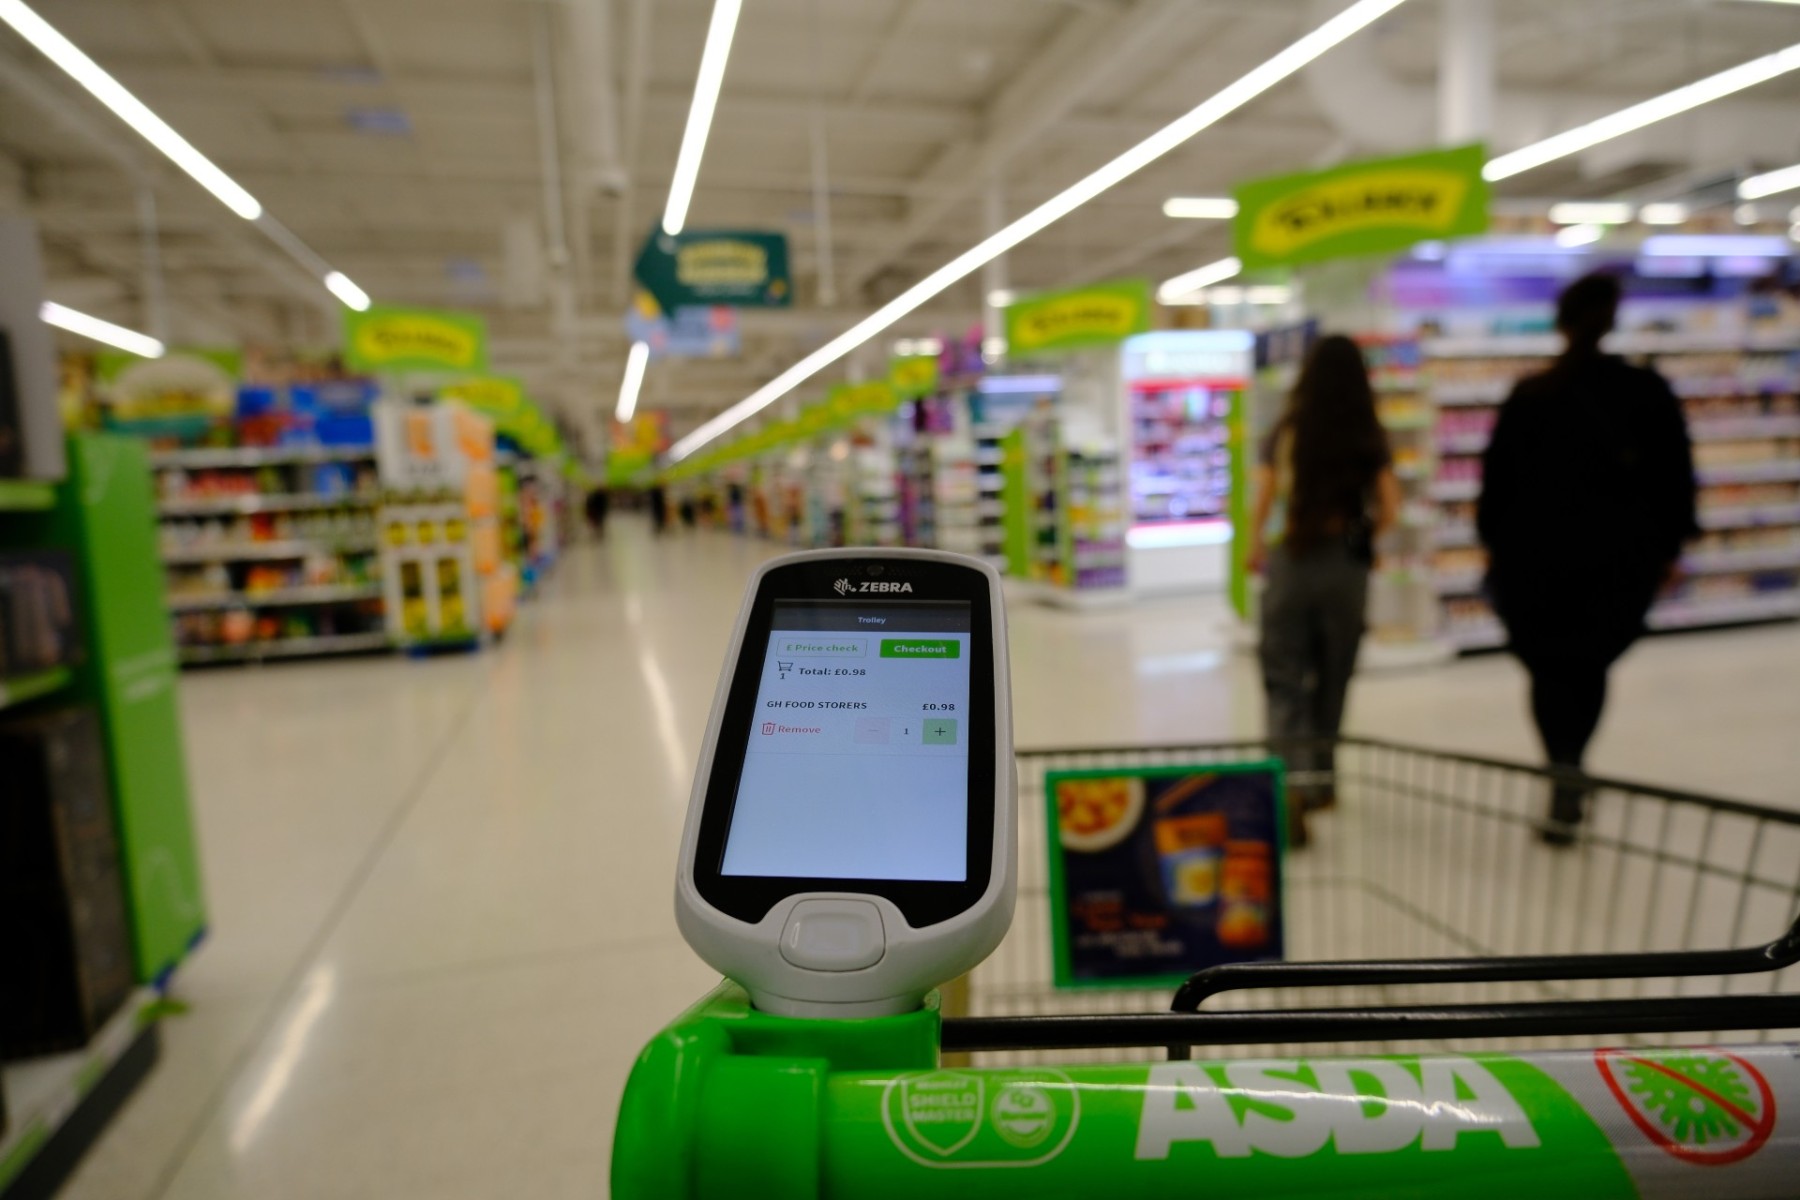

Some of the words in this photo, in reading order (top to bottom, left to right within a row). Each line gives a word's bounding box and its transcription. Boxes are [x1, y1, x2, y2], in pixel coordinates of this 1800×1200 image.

[859, 582, 913, 593] ZEBRA
[858, 616, 886, 625] Trolley
[795, 644, 823, 652] Price
[826, 644, 858, 652] check
[894, 645, 947, 654] Checkout
[799, 667, 831, 676] Total:
[834, 668, 866, 676] £0.98
[785, 701, 815, 709] FOOD
[818, 702, 867, 710] STORERS
[922, 703, 955, 711] £0.98
[778, 725, 821, 734] Remove
[1134, 1057, 1541, 1160] ASDA
